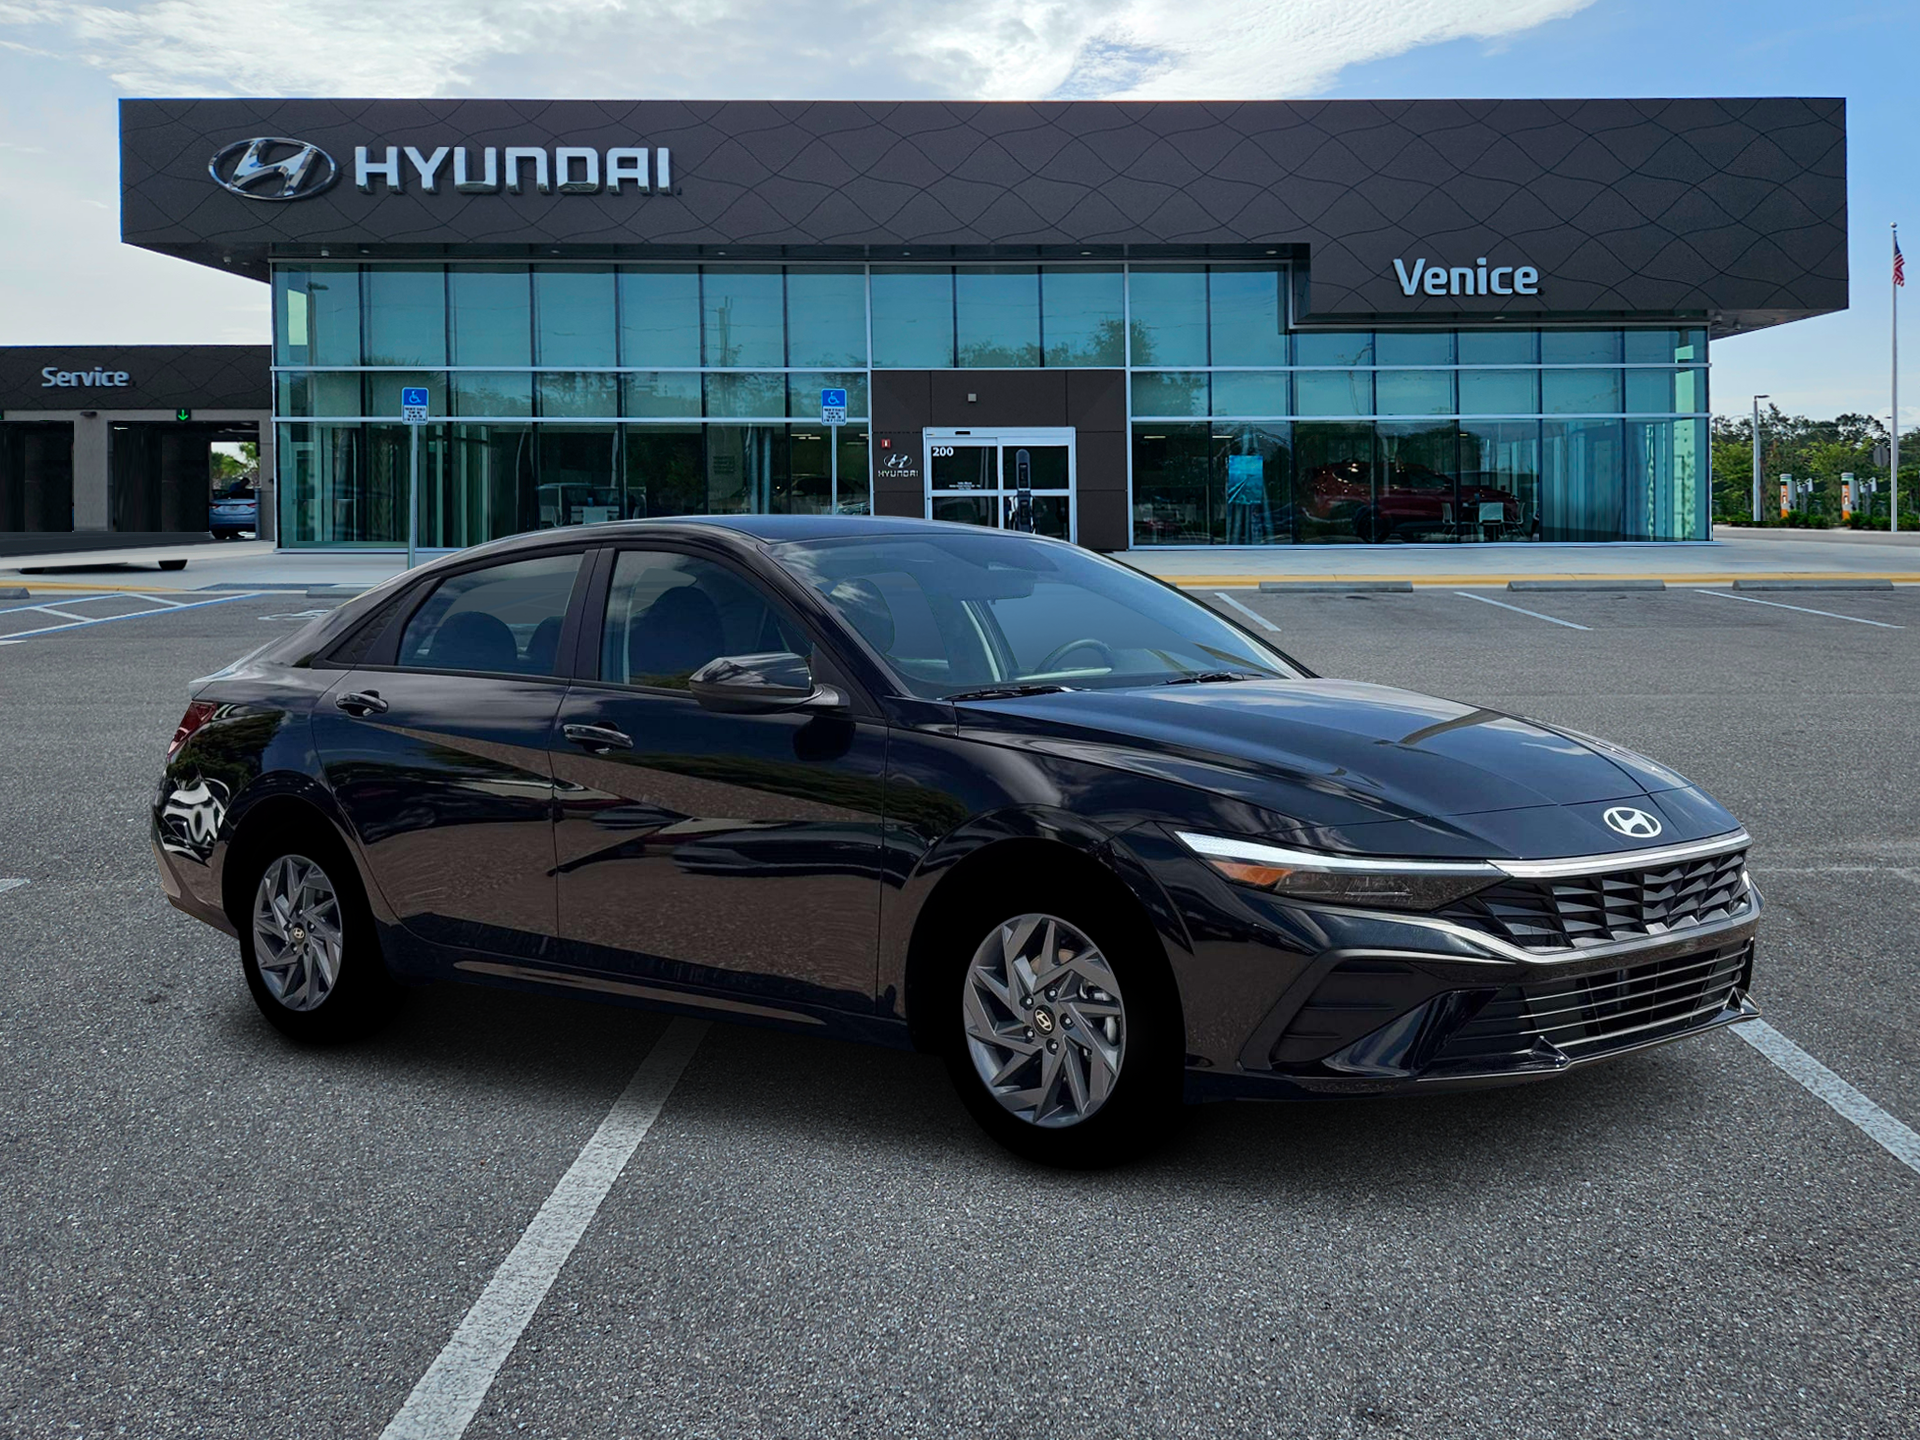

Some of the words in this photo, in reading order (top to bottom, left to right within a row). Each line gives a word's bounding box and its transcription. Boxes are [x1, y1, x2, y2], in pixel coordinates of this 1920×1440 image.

[354, 146, 673, 194] HYUNDAI
[1392, 257, 1539, 296] Venice
[41, 366, 130, 387] Service
[932, 446, 954, 457] 200
